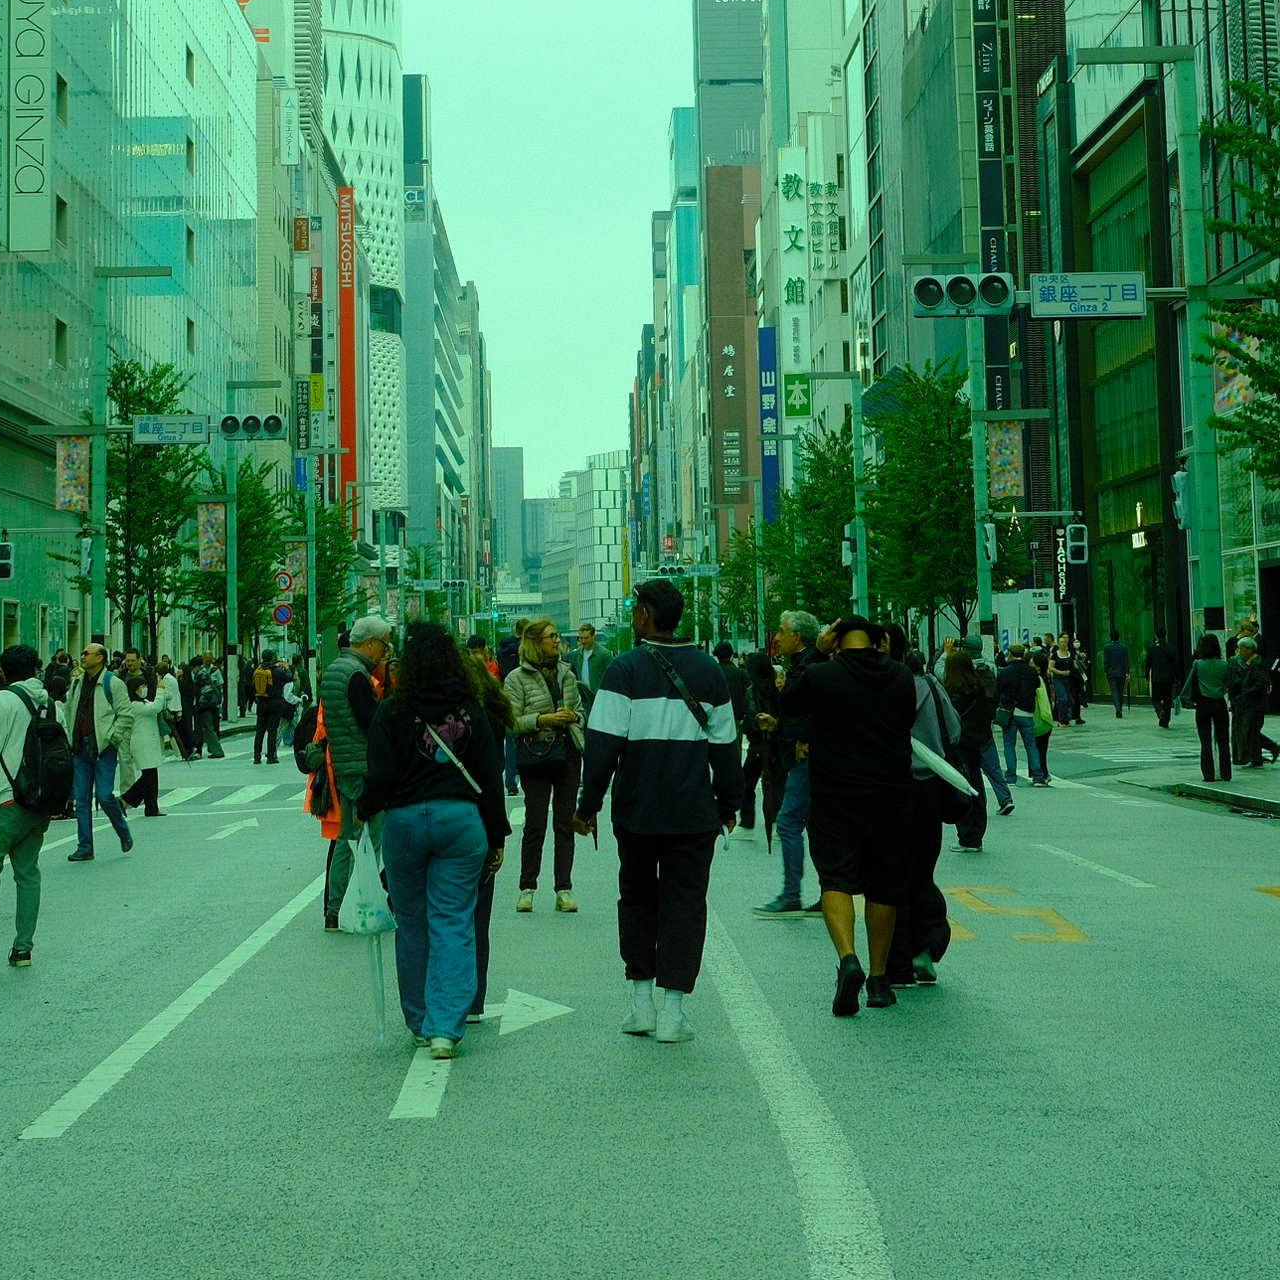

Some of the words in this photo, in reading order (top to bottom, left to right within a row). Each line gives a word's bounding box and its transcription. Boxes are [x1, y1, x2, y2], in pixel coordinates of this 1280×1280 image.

[340, 194, 353, 288] MITSUKOSHI
[781, 172, 805, 306] 教文館
[1038, 275, 1069, 283] 中央区
[1039, 284, 1138, 303] 銀座二丁目
[1069, 302, 1098, 313] Ginza
[1102, 302, 1109, 312] 2
[138, 422, 205, 434] 銀座二丁目
